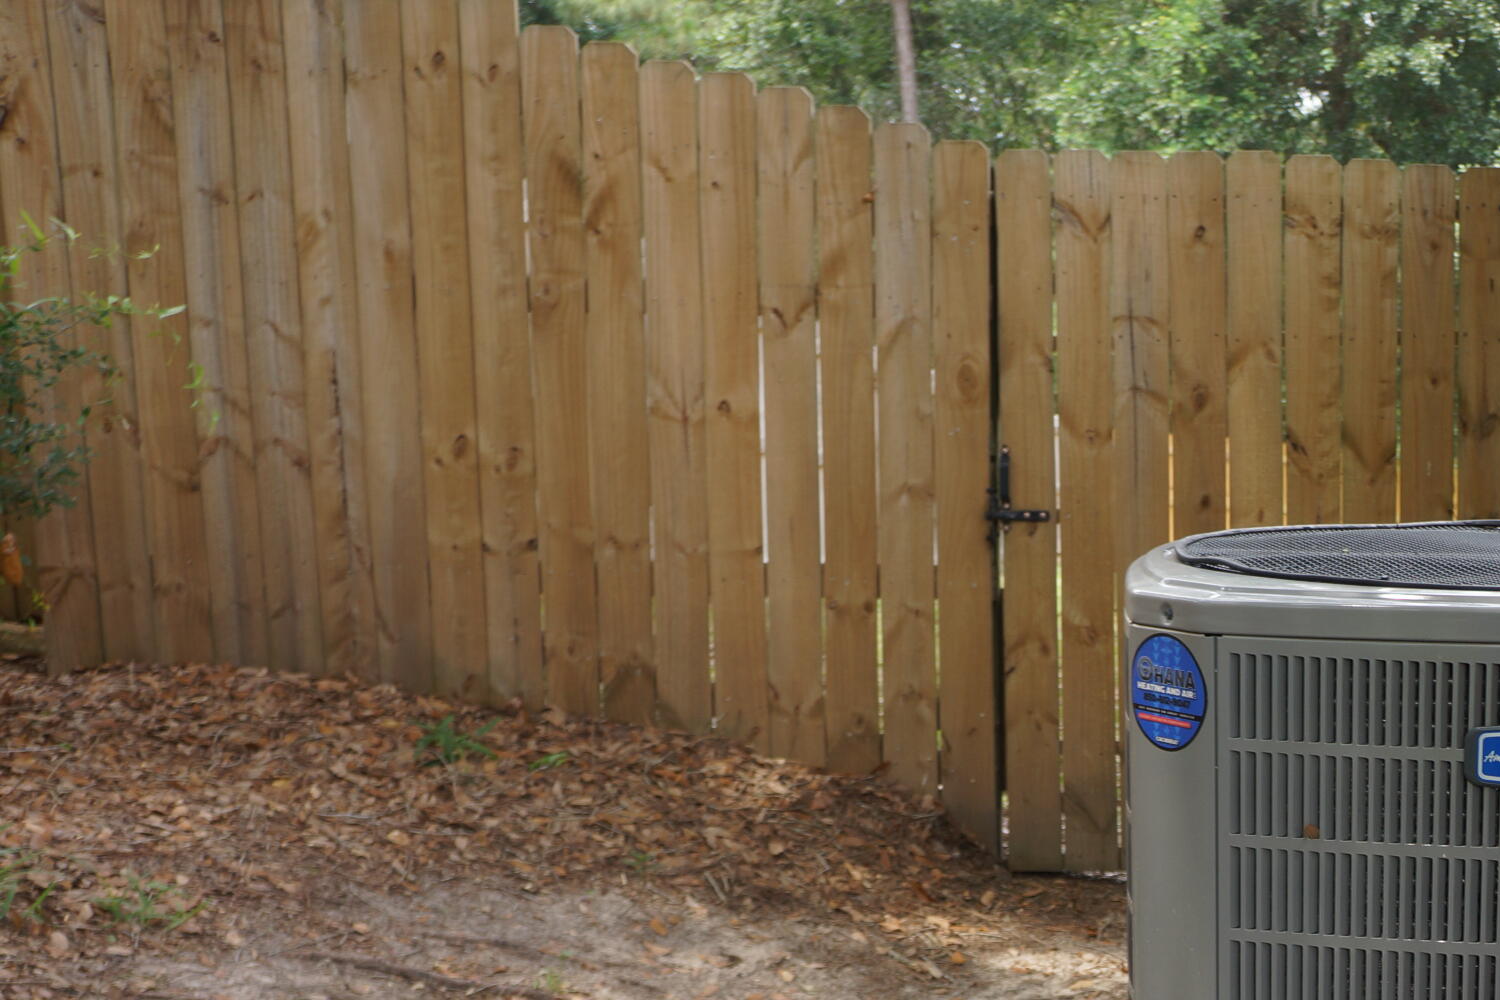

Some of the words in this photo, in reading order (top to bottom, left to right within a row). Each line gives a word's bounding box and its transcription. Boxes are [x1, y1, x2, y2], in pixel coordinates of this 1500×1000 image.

[1138, 656, 1195, 688] OHANA
[1137, 681, 1165, 693] HEATING
[1166, 687, 1181, 696] AND
